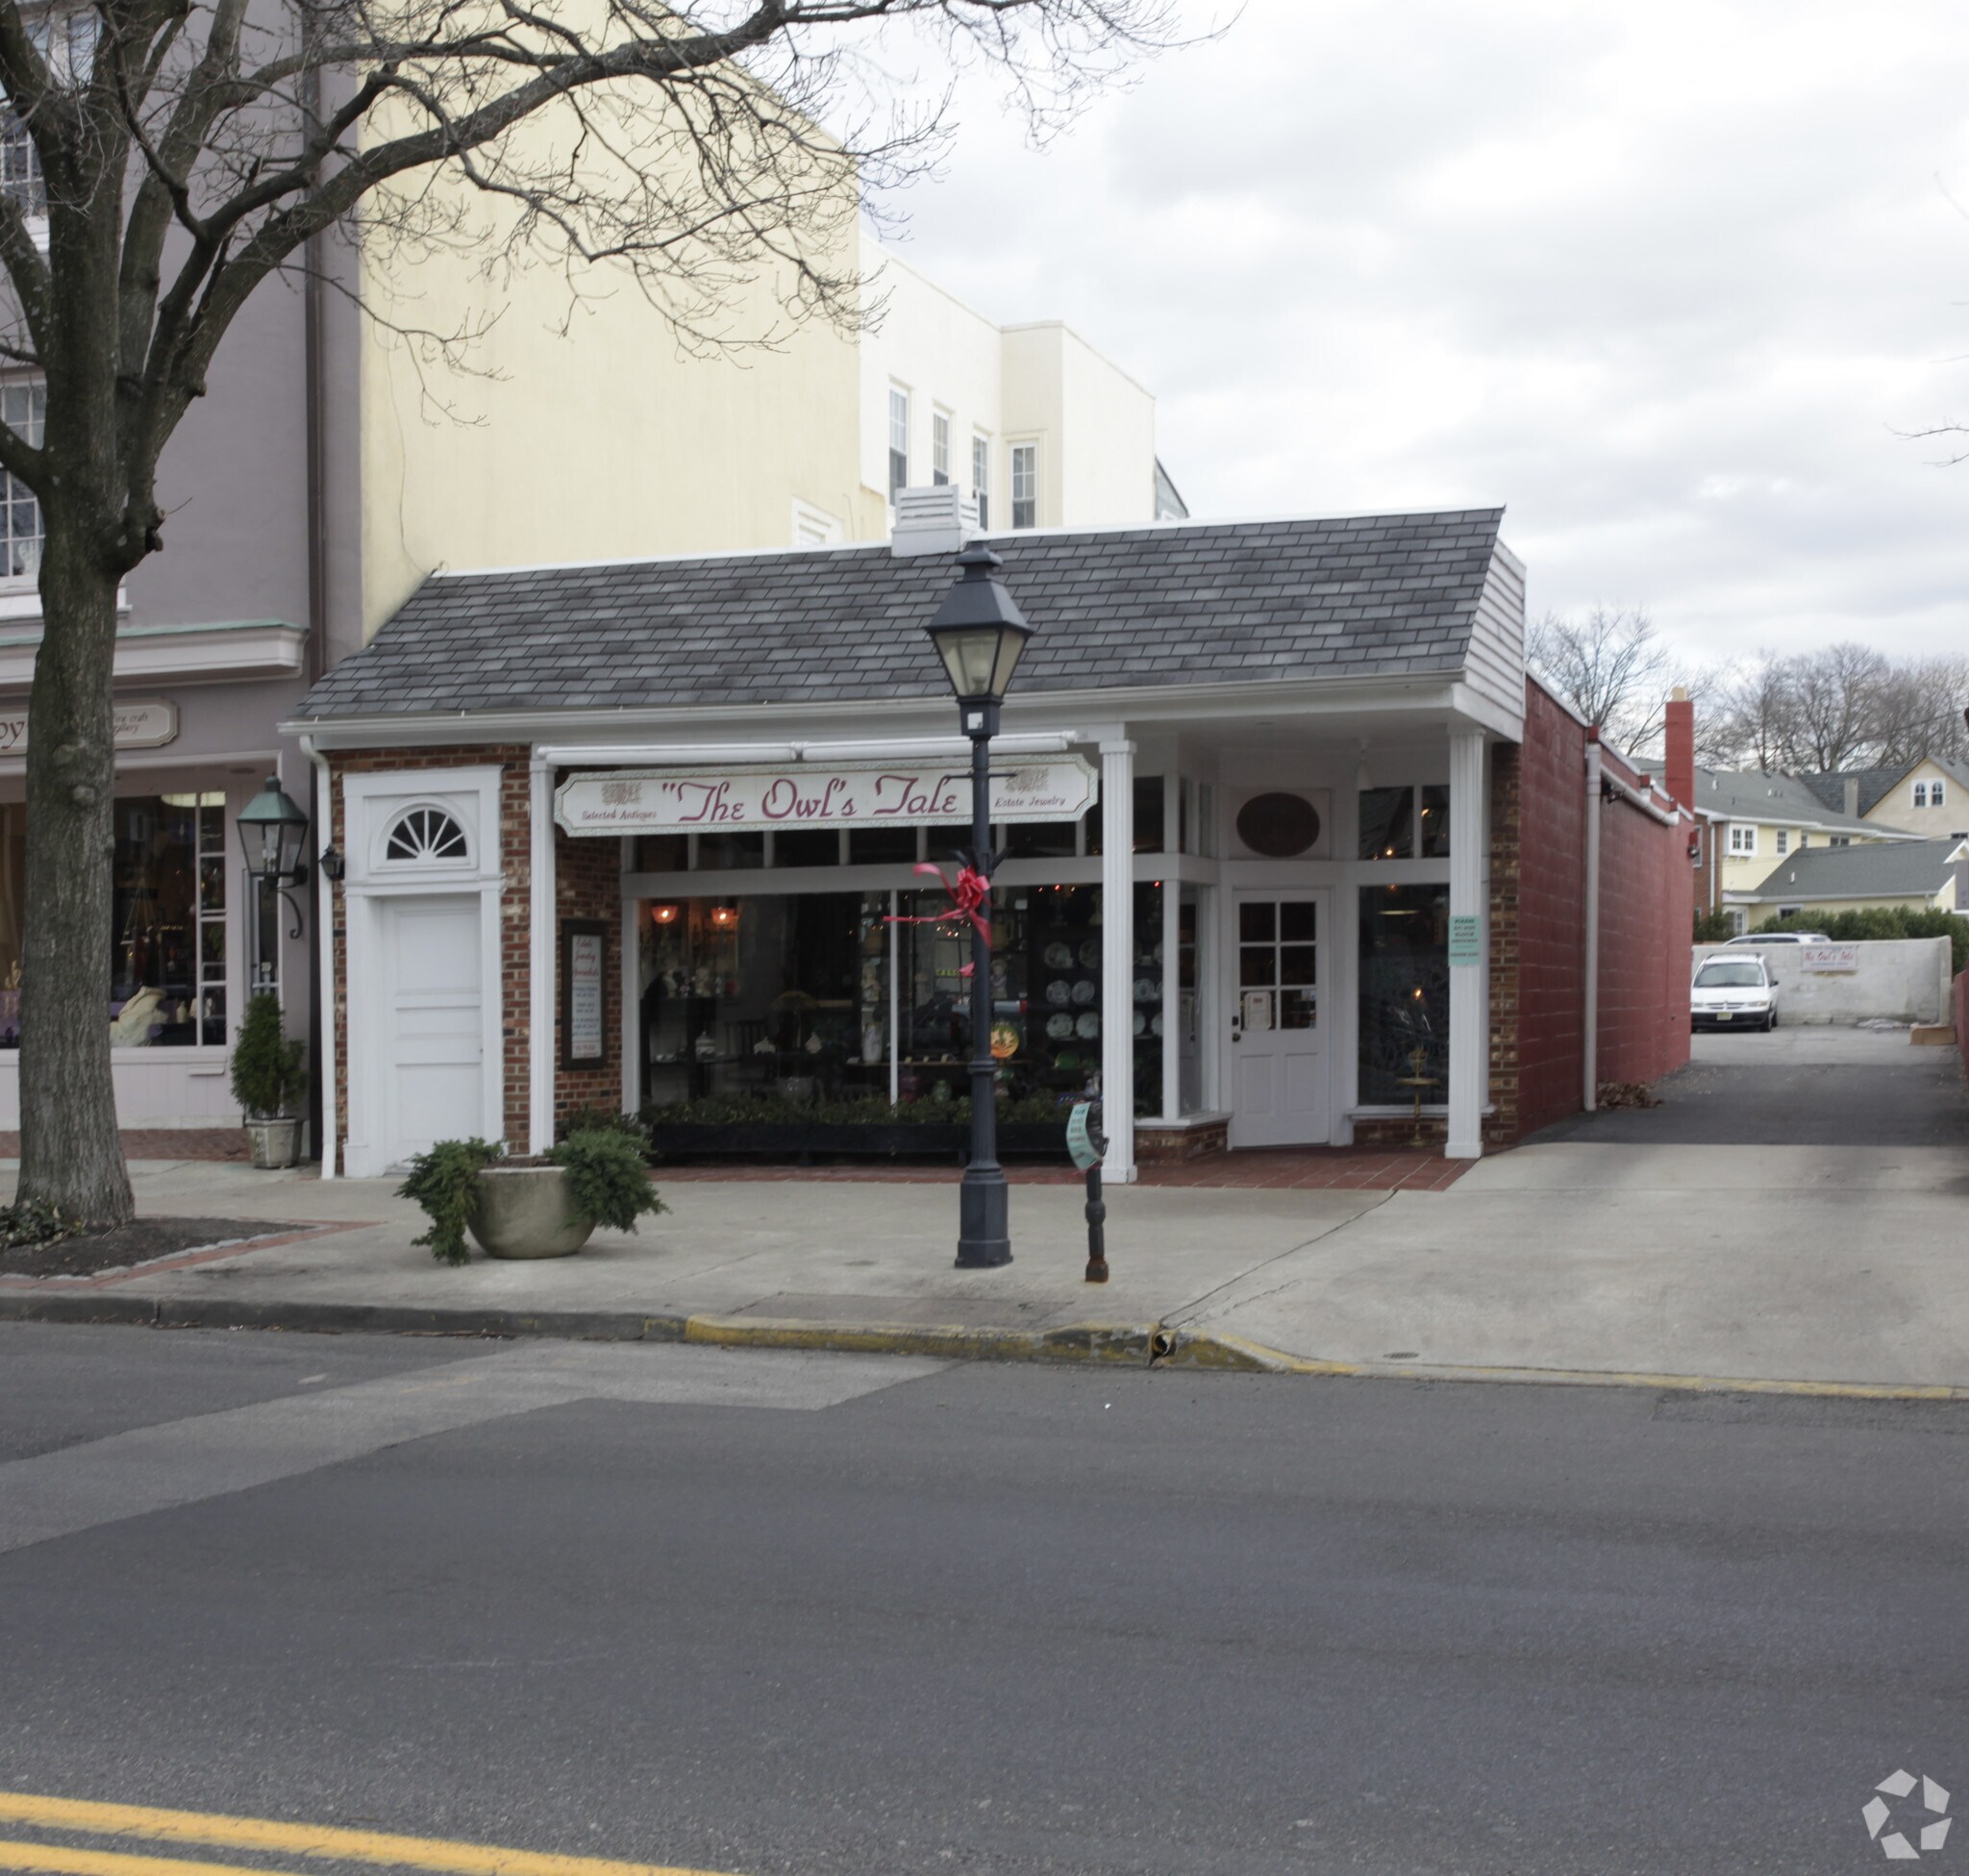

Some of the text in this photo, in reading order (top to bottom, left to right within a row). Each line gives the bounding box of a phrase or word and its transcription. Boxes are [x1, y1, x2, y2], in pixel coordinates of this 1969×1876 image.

[761, 778, 858, 818] Owl's
[873, 774, 958, 817] Tale
[994, 795, 1065, 809] Estate Jewelry
[582, 808, 657, 821] Selected Antiques
